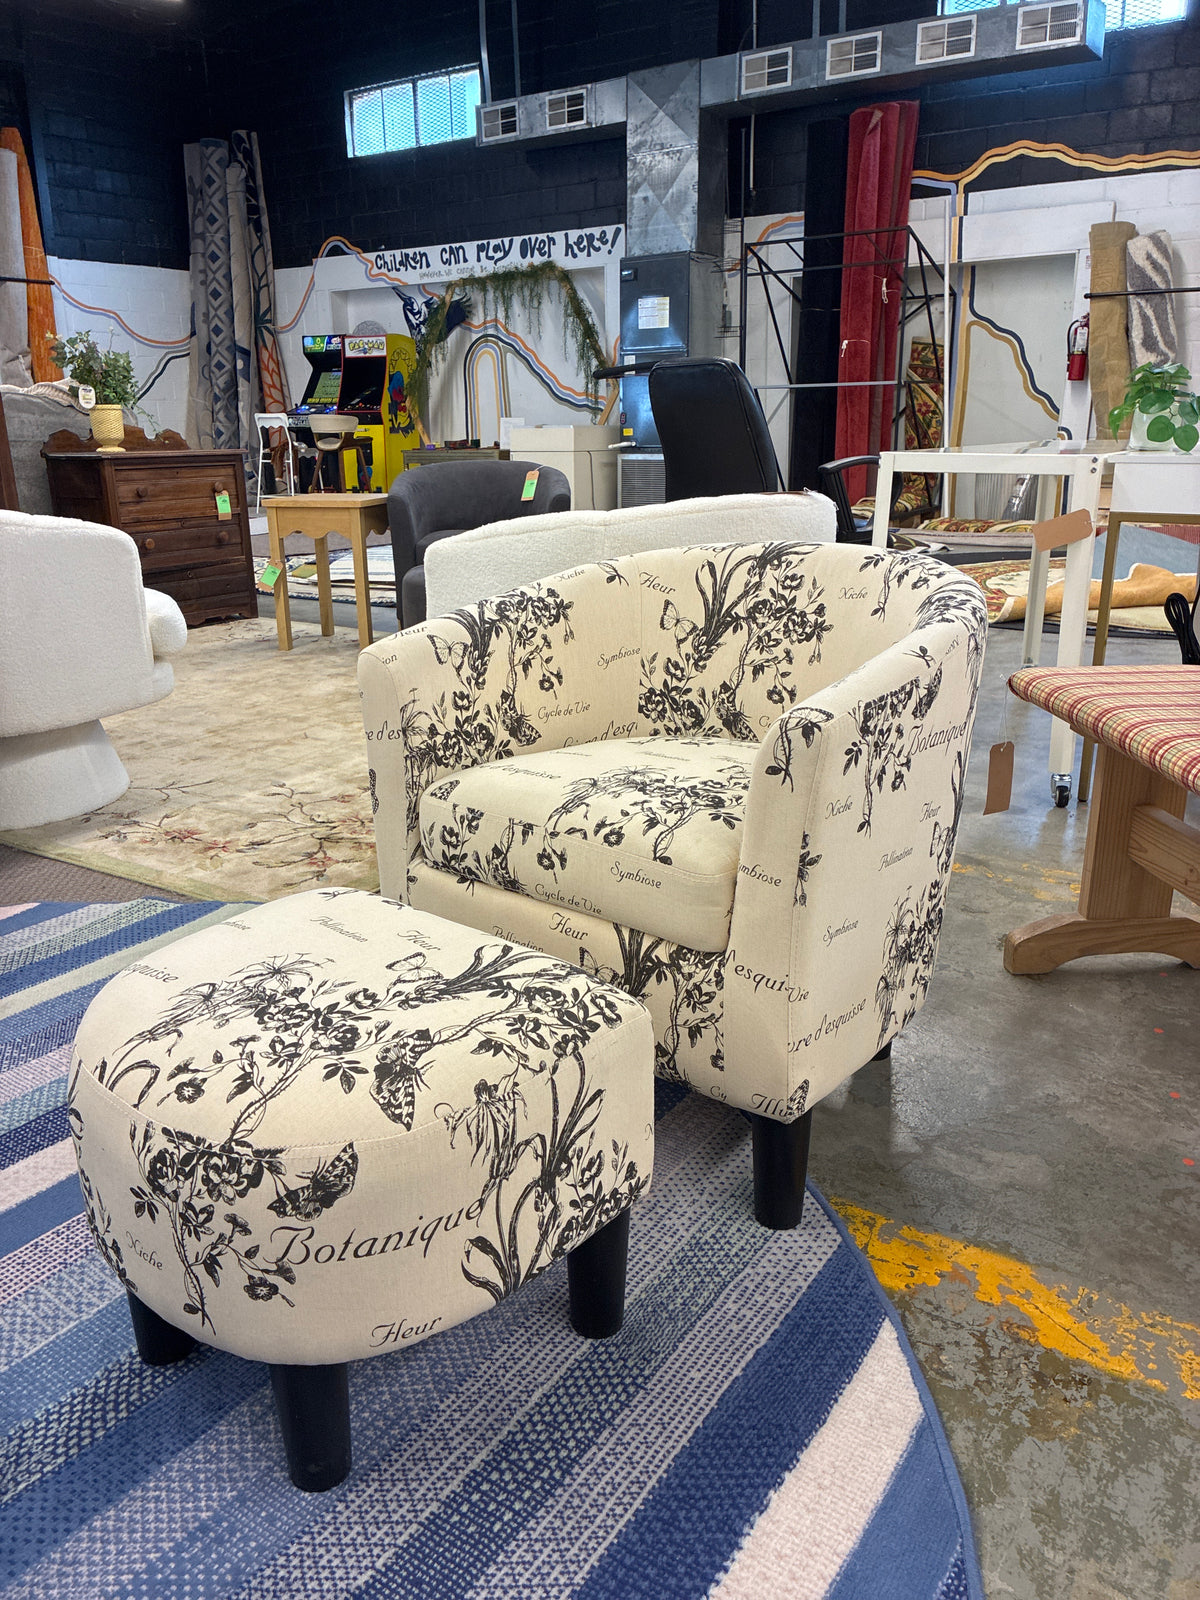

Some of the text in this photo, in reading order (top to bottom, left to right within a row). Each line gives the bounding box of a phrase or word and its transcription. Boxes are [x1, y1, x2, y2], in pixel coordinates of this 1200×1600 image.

[348, 339, 385, 351] PAC-MAN
[639, 571, 676, 595] Fleur
[597, 646, 641, 670] Symbiose
[537, 701, 591, 724] Cycle de Vie
[903, 720, 968, 758] Botanique
[919, 800, 941, 823] Fleur
[610, 860, 662, 889] Symbiose
[534, 883, 602, 914] Cycle de Vie
[396, 929, 441, 951] Fleur
[549, 911, 589, 941] Fleur
[823, 918, 859, 947] Symbiose
[786, 986, 810, 1004] Vie
[814, 998, 867, 1040] d'esquisse
[262, 1198, 483, 1266] Botanique
[369, 1317, 442, 1349] Fleur
